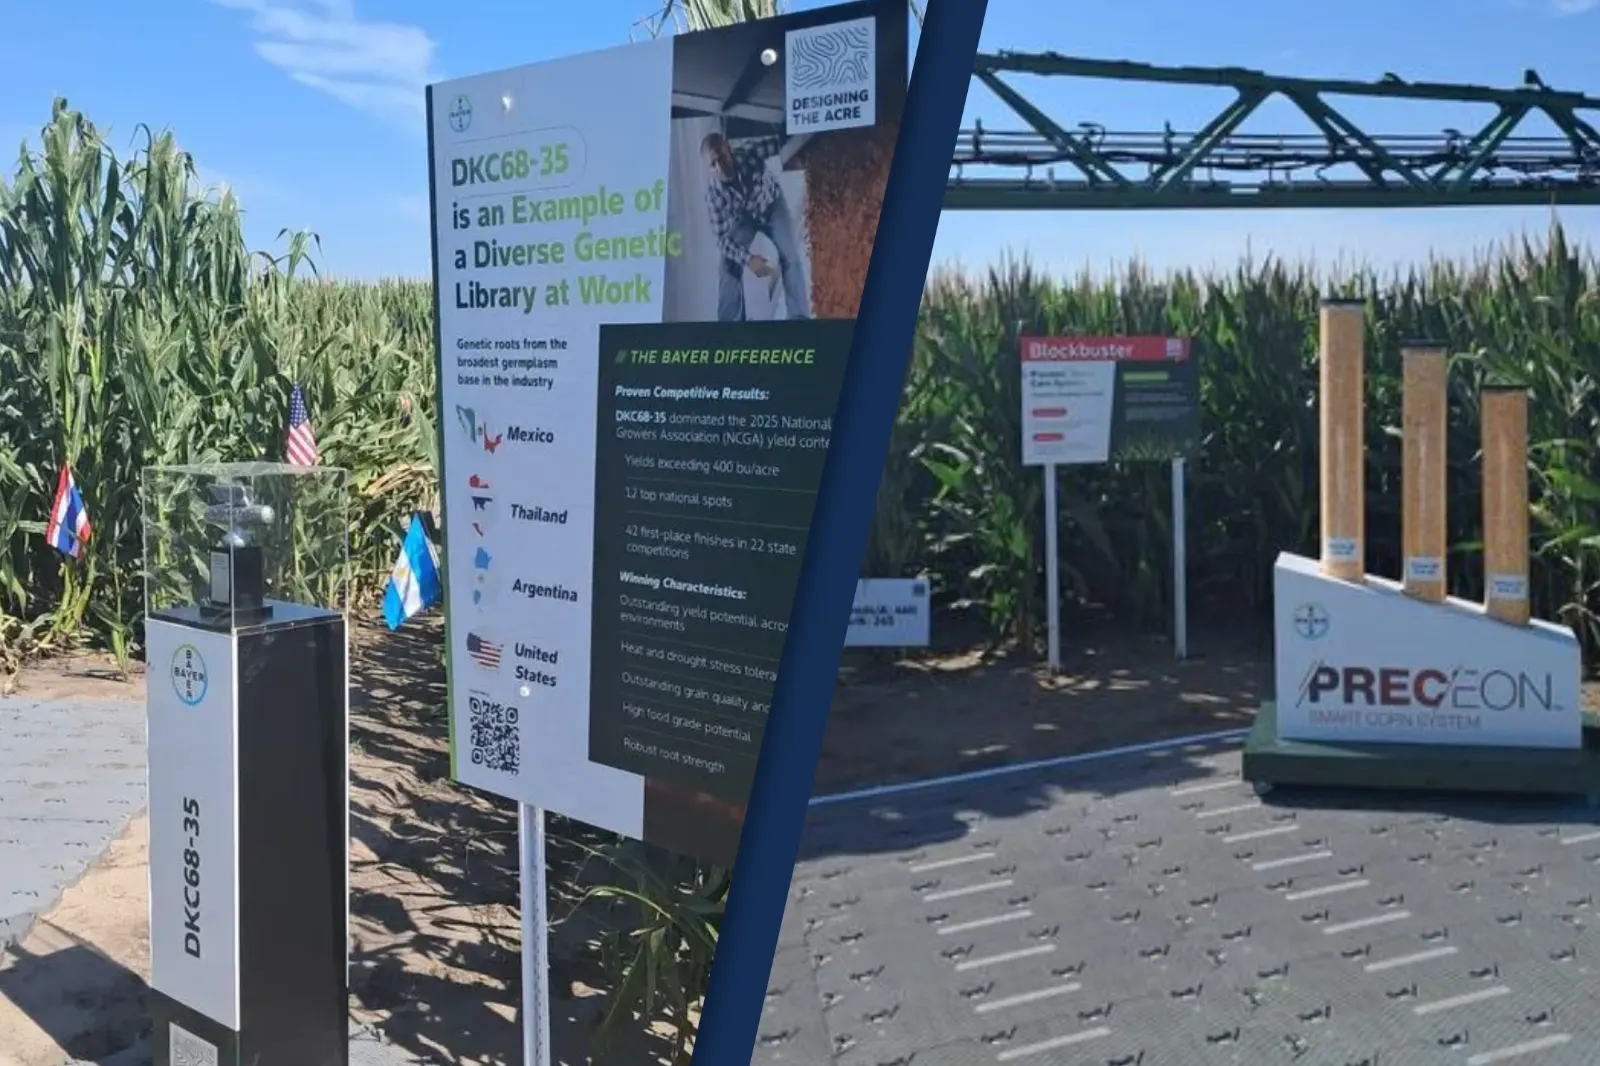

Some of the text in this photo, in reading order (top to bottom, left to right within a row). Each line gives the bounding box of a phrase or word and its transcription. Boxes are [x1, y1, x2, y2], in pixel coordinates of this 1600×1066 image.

[793, 89, 869, 110] DESIGNING
[793, 106, 861, 126] THE ACRE
[452, 143, 569, 186] DKC68-35
[453, 179, 664, 229] is an Example of
[455, 224, 683, 269] a Diverse Genetic
[456, 274, 652, 314] Library at Work
[457, 338, 567, 350] Genetic roots from the
[1030, 342, 1134, 358] Blockbuster
[458, 357, 558, 371] broadest germplasm
[631, 349, 815, 364] THE BAYER DIFFERENCE
[458, 374, 554, 391] base in the industry
[615, 385, 770, 400] Proven Competitive Results:
[615, 410, 832, 430] DKC68-35 dominated the 2025 National
[507, 425, 554, 443] Mexico
[616, 426, 657, 440] Growers
[660, 429, 719, 443] Association
[723, 430, 764, 447] (NCGA)
[766, 433, 796, 449] yield
[625, 454, 780, 476] Yields exceeding 400 bu/acre
[626, 487, 732, 508] 12 top national spots
[511, 503, 568, 524] Thailand
[625, 525, 796, 555] 42 first-place finishes in 22 state
[626, 542, 689, 559] competitions
[512, 578, 578, 602] Argentina
[620, 571, 747, 600] Winning Characteristics:
[620, 594, 679, 617] Outstanding
[682, 604, 708, 619] yield
[710, 609, 757, 628] potential
[620, 611, 685, 632] environments
[514, 642, 558, 664] United
[621, 641, 643, 656] Heat
[646, 647, 664, 660] and
[667, 649, 707, 668] drought
[710, 657, 741, 674] stress
[515, 665, 557, 687] States
[622, 672, 682, 696] Outstanding
[684, 684, 709, 700] grain
[712, 689, 748, 711] quality
[622, 702, 751, 742] High food grade potential
[623, 737, 725, 774] Robust root strength
[183, 797, 200, 959] DKC68-35
